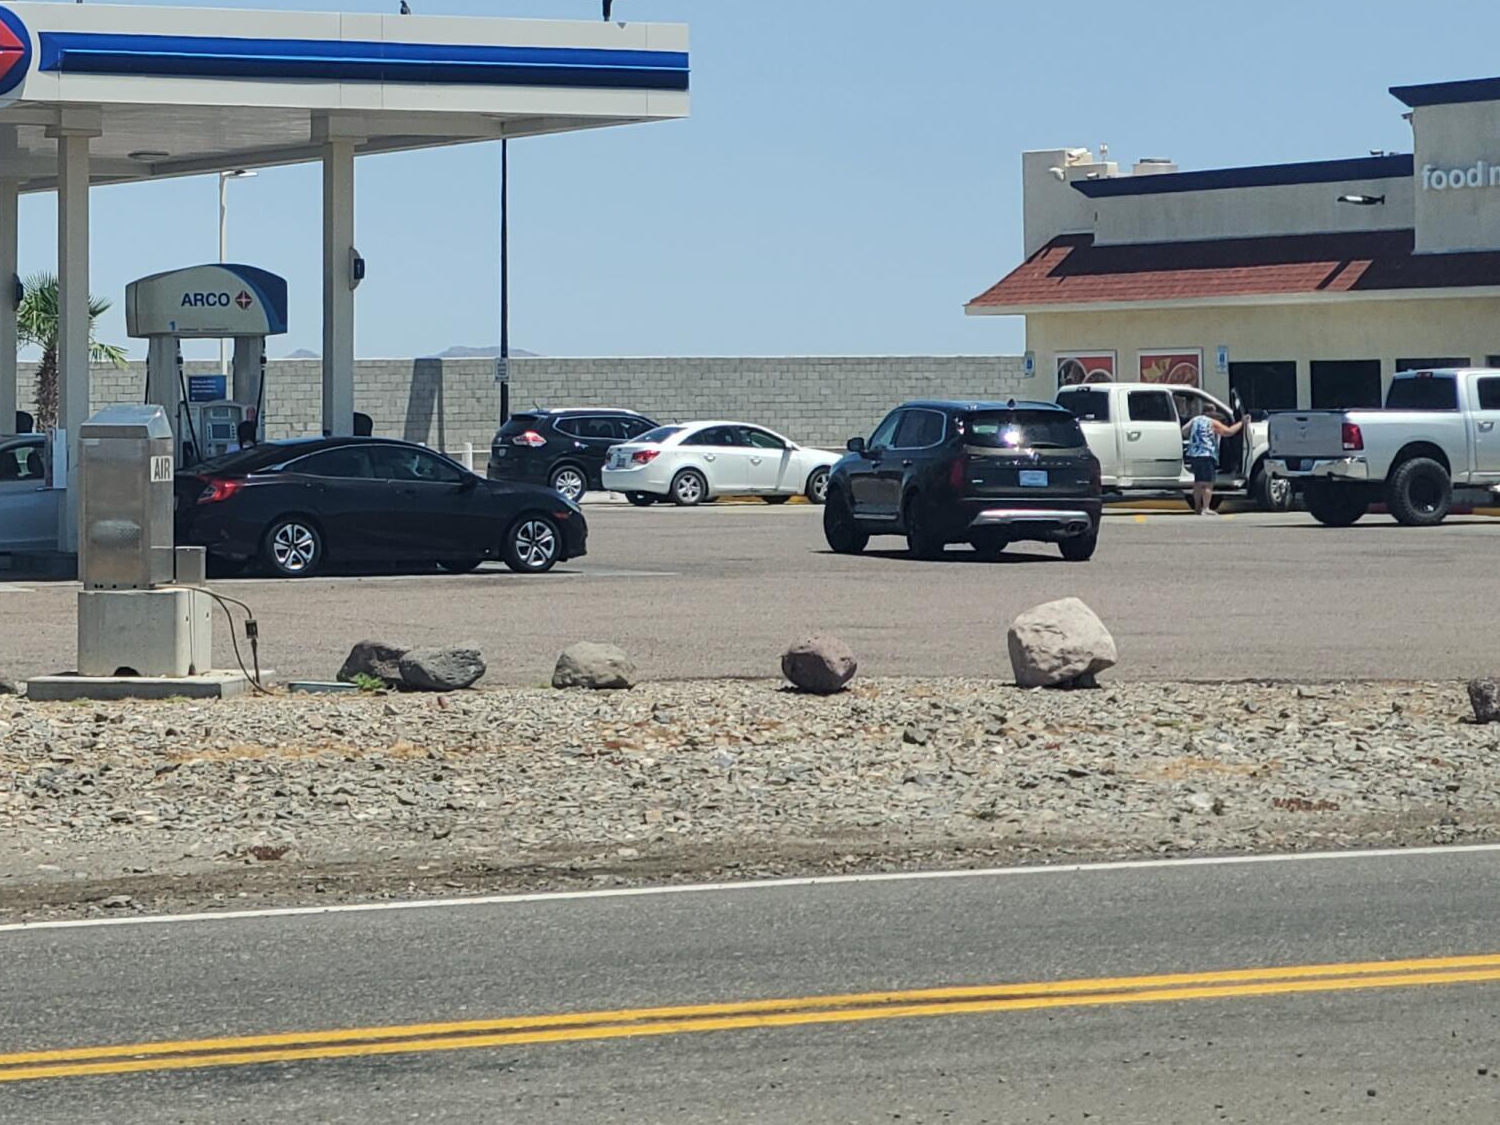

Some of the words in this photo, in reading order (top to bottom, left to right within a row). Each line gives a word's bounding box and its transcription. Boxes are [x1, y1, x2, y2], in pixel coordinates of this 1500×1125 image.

[1422, 160, 1483, 190] food
[180, 292, 230, 307] ARCO
[169, 321, 176, 331] 1
[153, 458, 171, 480] AIR
